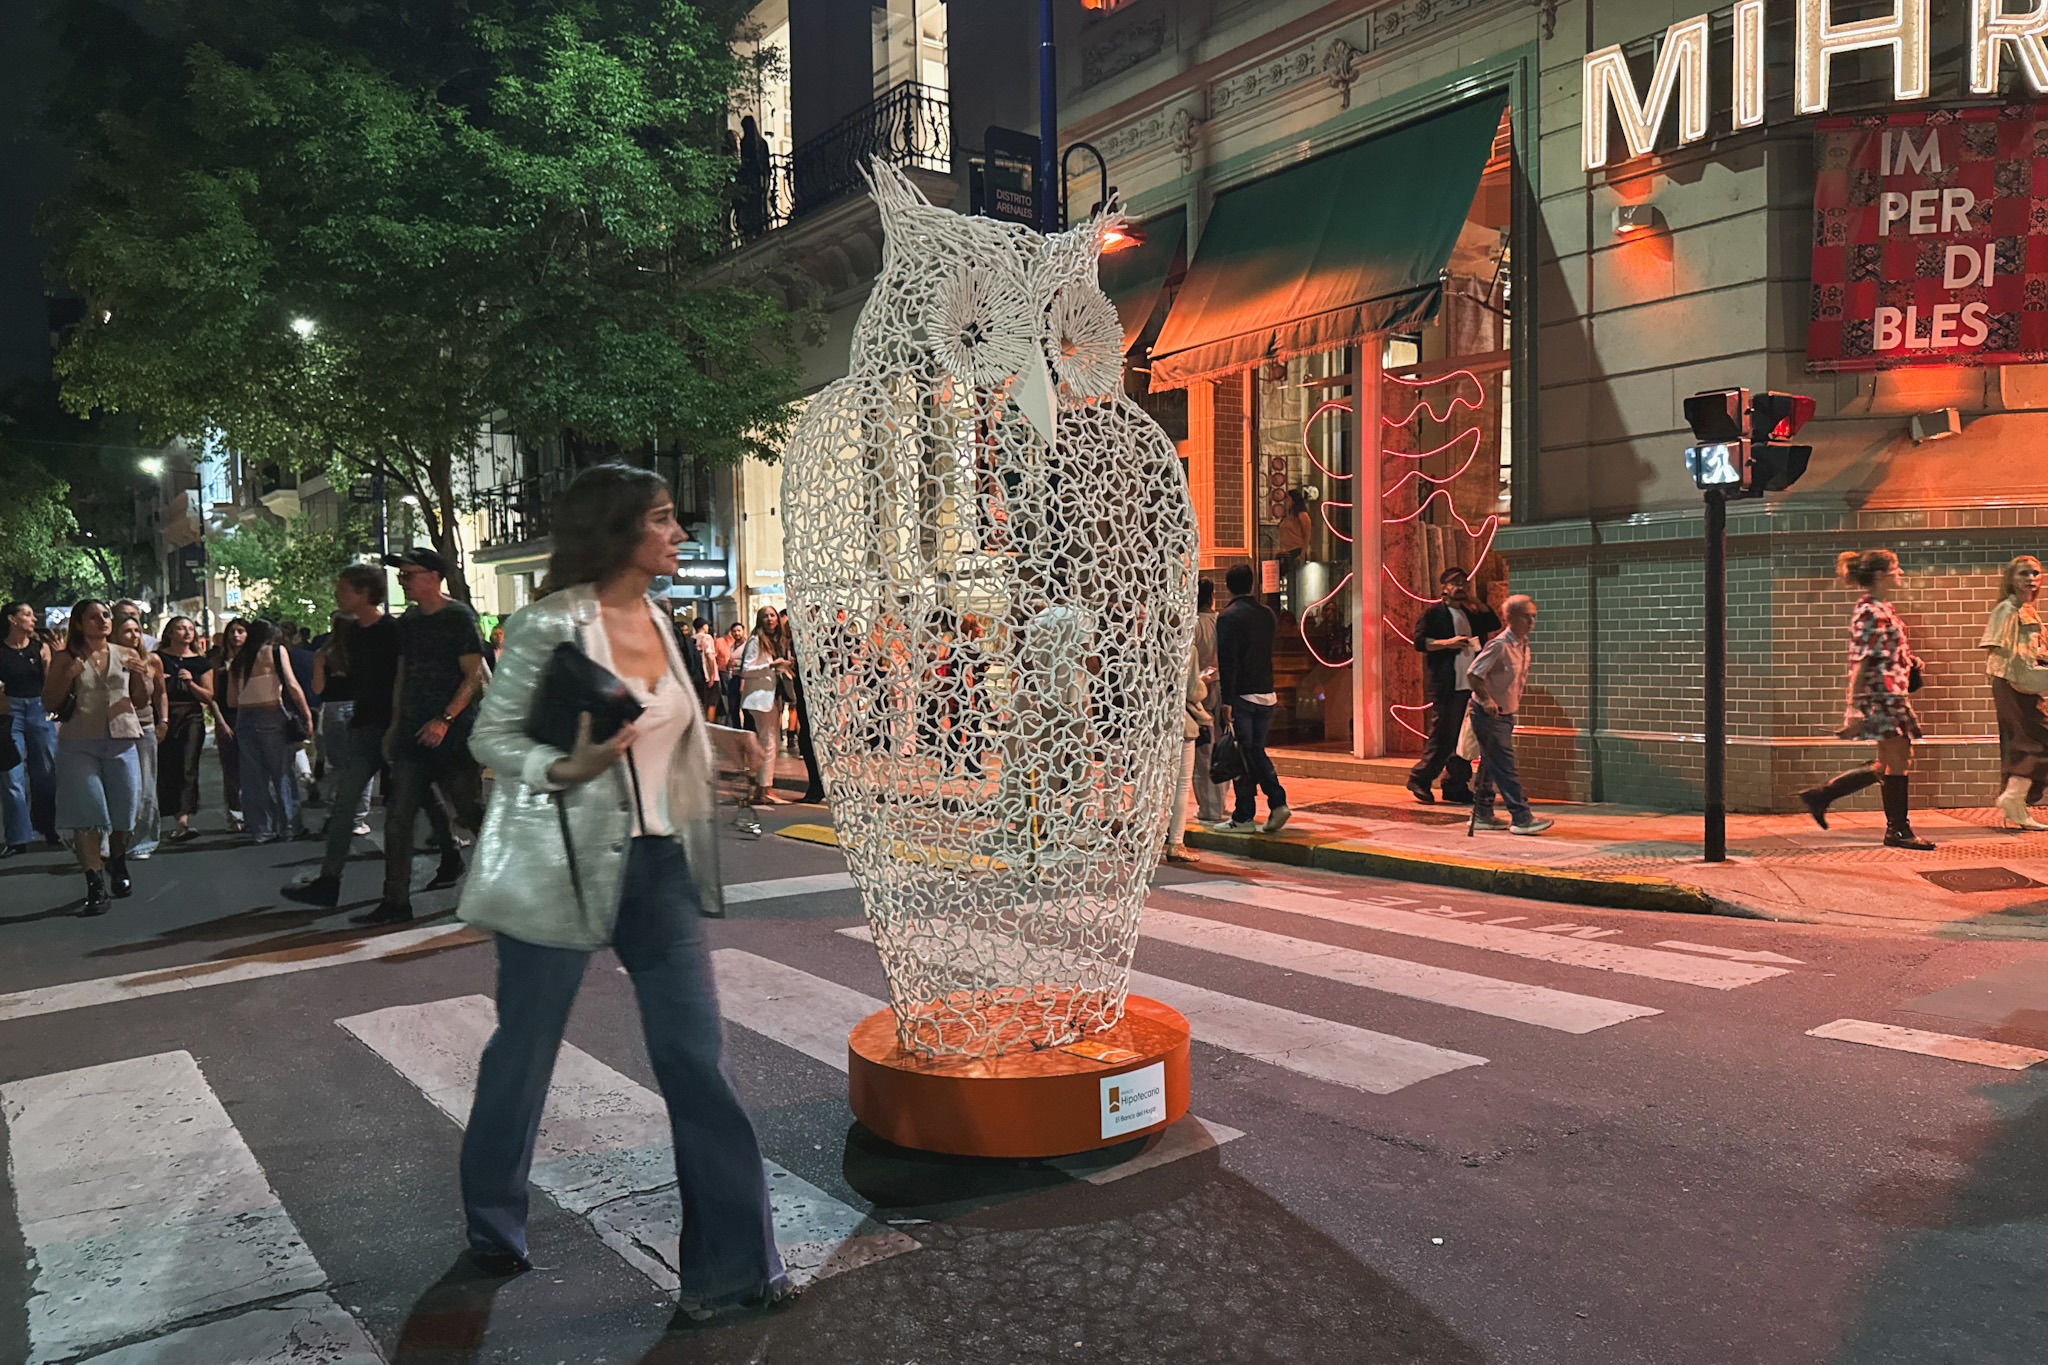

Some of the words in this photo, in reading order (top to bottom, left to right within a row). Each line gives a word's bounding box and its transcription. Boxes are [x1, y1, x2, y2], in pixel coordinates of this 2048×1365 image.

[1582, 0, 2048, 172] MIHR
[1879, 128, 1942, 177] IM
[996, 189, 1032, 207] DISTRITO
[996, 202, 1033, 218] ARENALES
[1878, 187, 1976, 237] PER
[1942, 243, 1996, 290] DI
[1873, 302, 1989, 351] BLES
[1115, 1116, 1120, 1124] El
[1121, 1113, 1135, 1122] Banco
[1144, 1106, 1156, 1115] Hogar
[1121, 1087, 1160, 1106] Hipotecario
